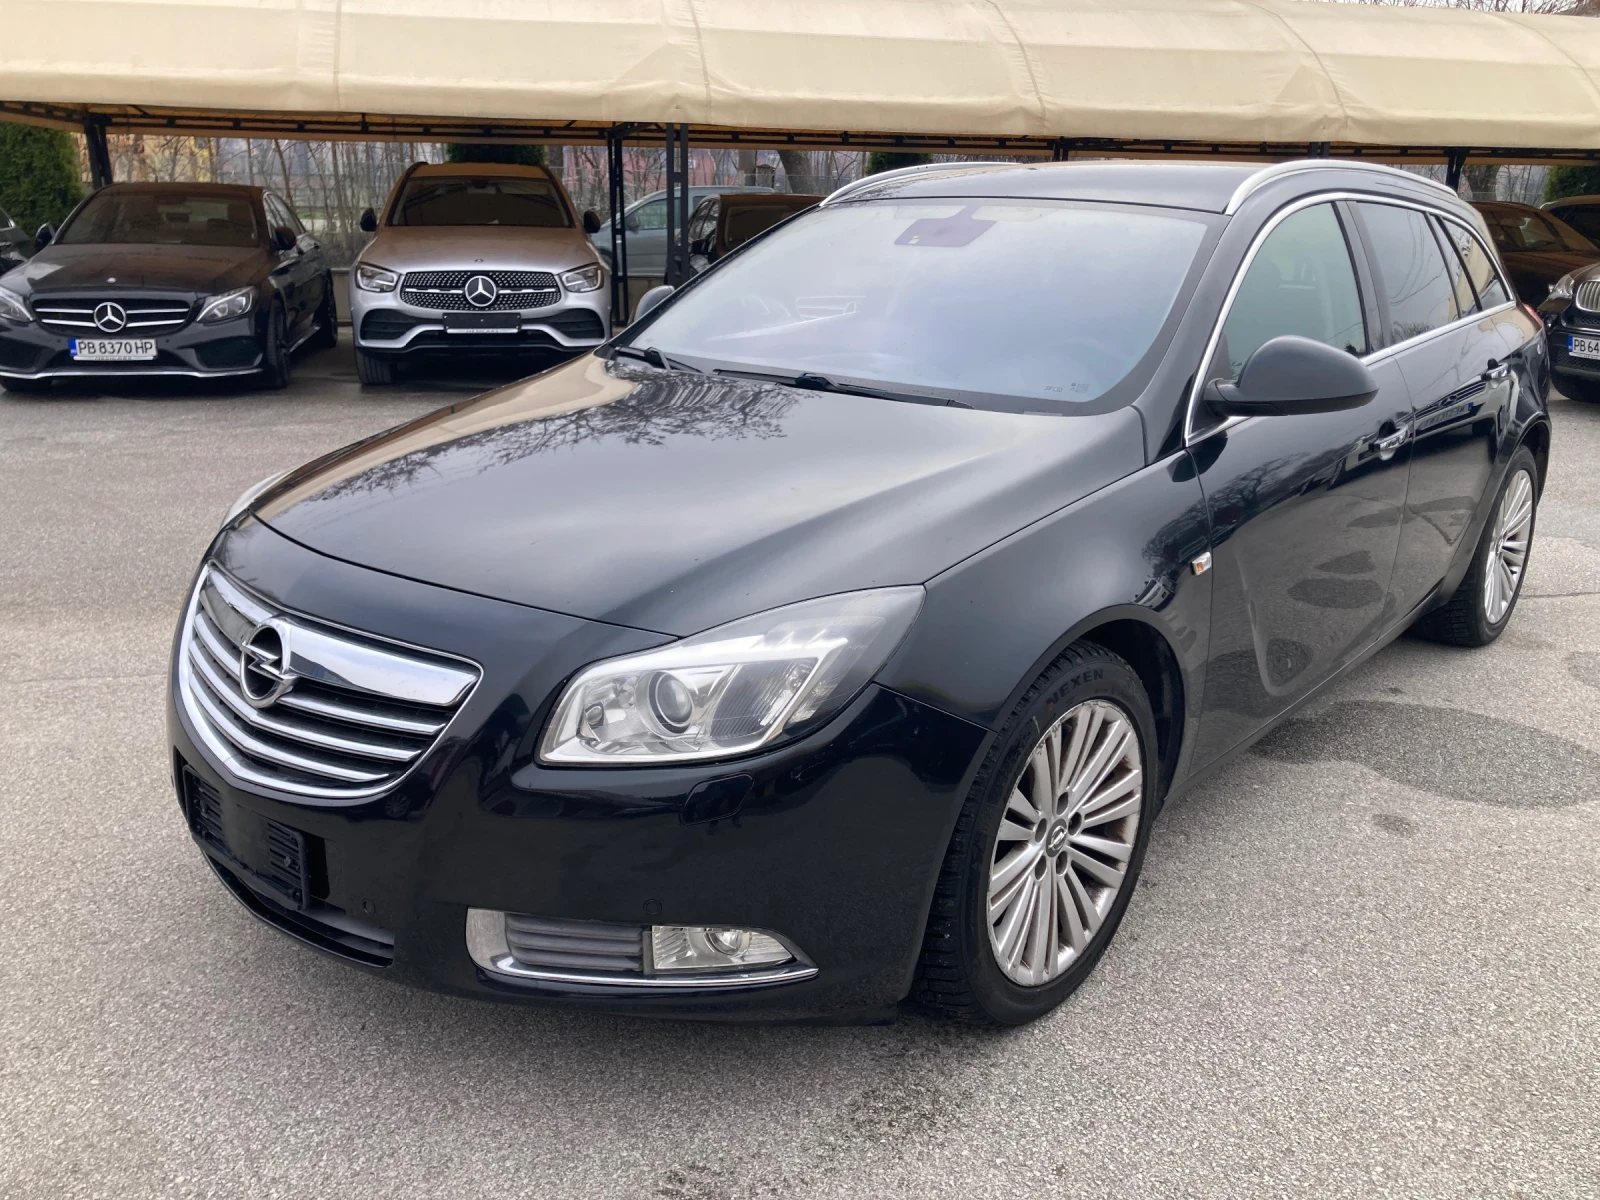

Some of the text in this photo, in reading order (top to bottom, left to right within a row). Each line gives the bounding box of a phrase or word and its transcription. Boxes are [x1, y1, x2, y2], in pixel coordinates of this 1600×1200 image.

[78, 341, 153, 355] PB 8370 HP
[1573, 338, 1600, 354] PB 64
[1046, 668, 1104, 704] NEXEN
